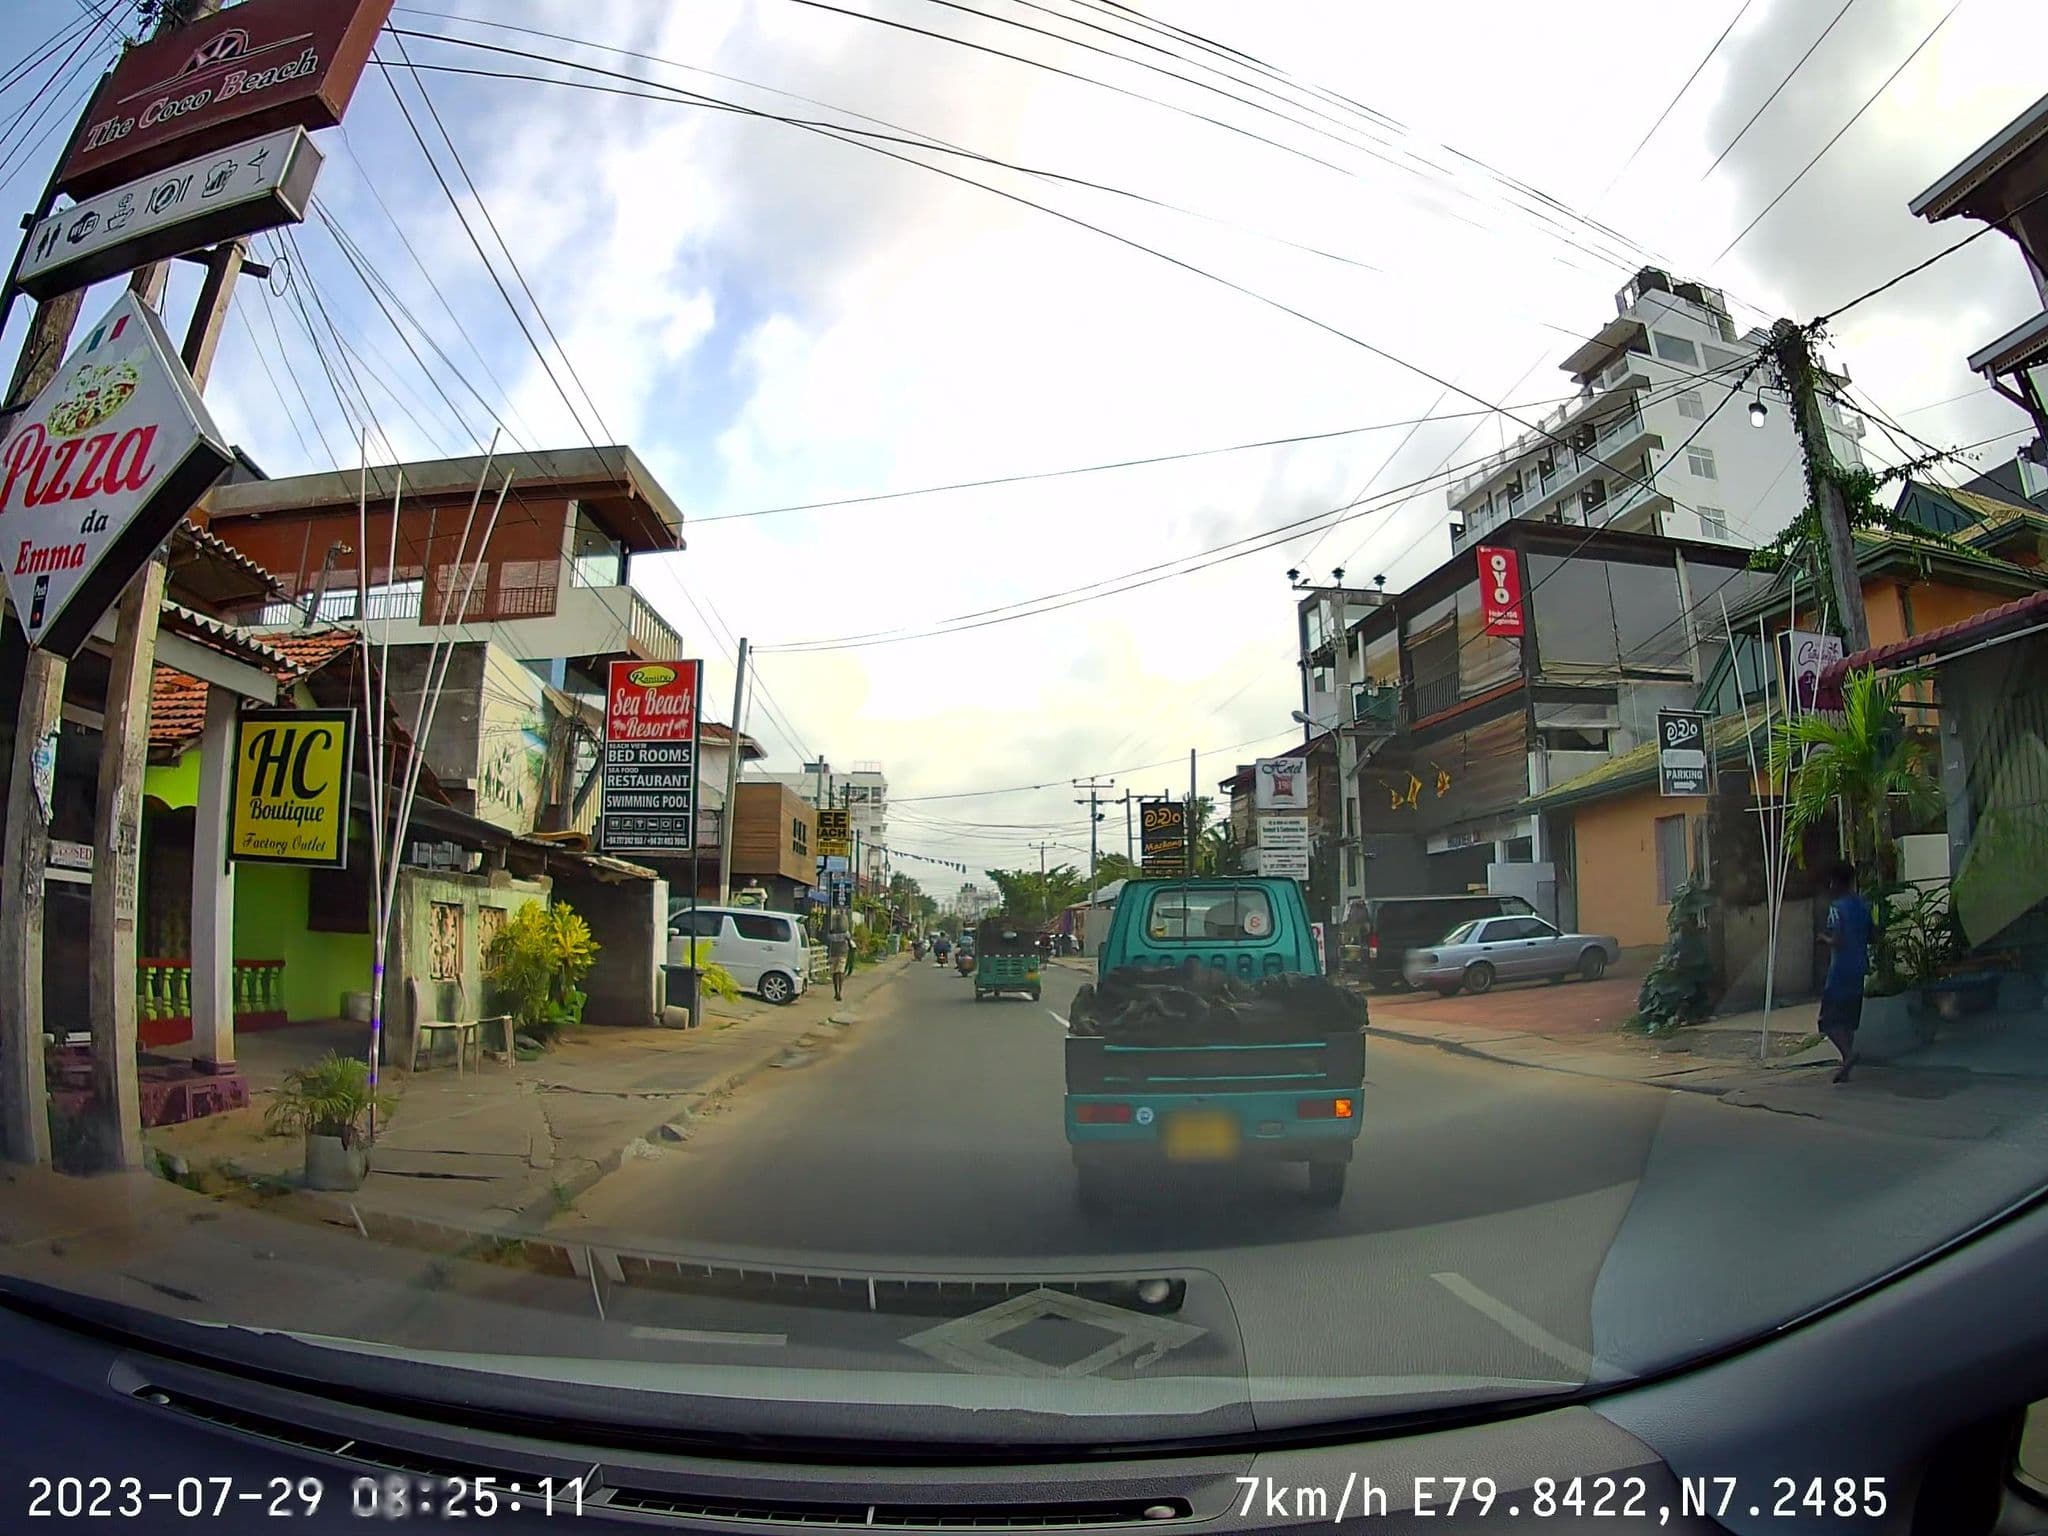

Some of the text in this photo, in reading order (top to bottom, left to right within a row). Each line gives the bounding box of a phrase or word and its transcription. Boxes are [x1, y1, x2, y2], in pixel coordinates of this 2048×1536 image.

[83, 47, 319, 153] The Coco Beach
[0, 423, 158, 514] Pizza
[81, 509, 109, 534] da
[14, 540, 87, 575] Emma
[613, 687, 690, 717] Sea Beach
[626, 716, 674, 738] Resort
[248, 728, 332, 800] HC
[608, 749, 690, 762] BED ROOMS
[607, 774, 689, 787] RESTAURANT
[1666, 770, 1703, 780] PARKING
[250, 799, 325, 828] Boutique
[606, 795, 689, 808] SWIMMING POOL
[243, 832, 326, 855] Factory Outlet
